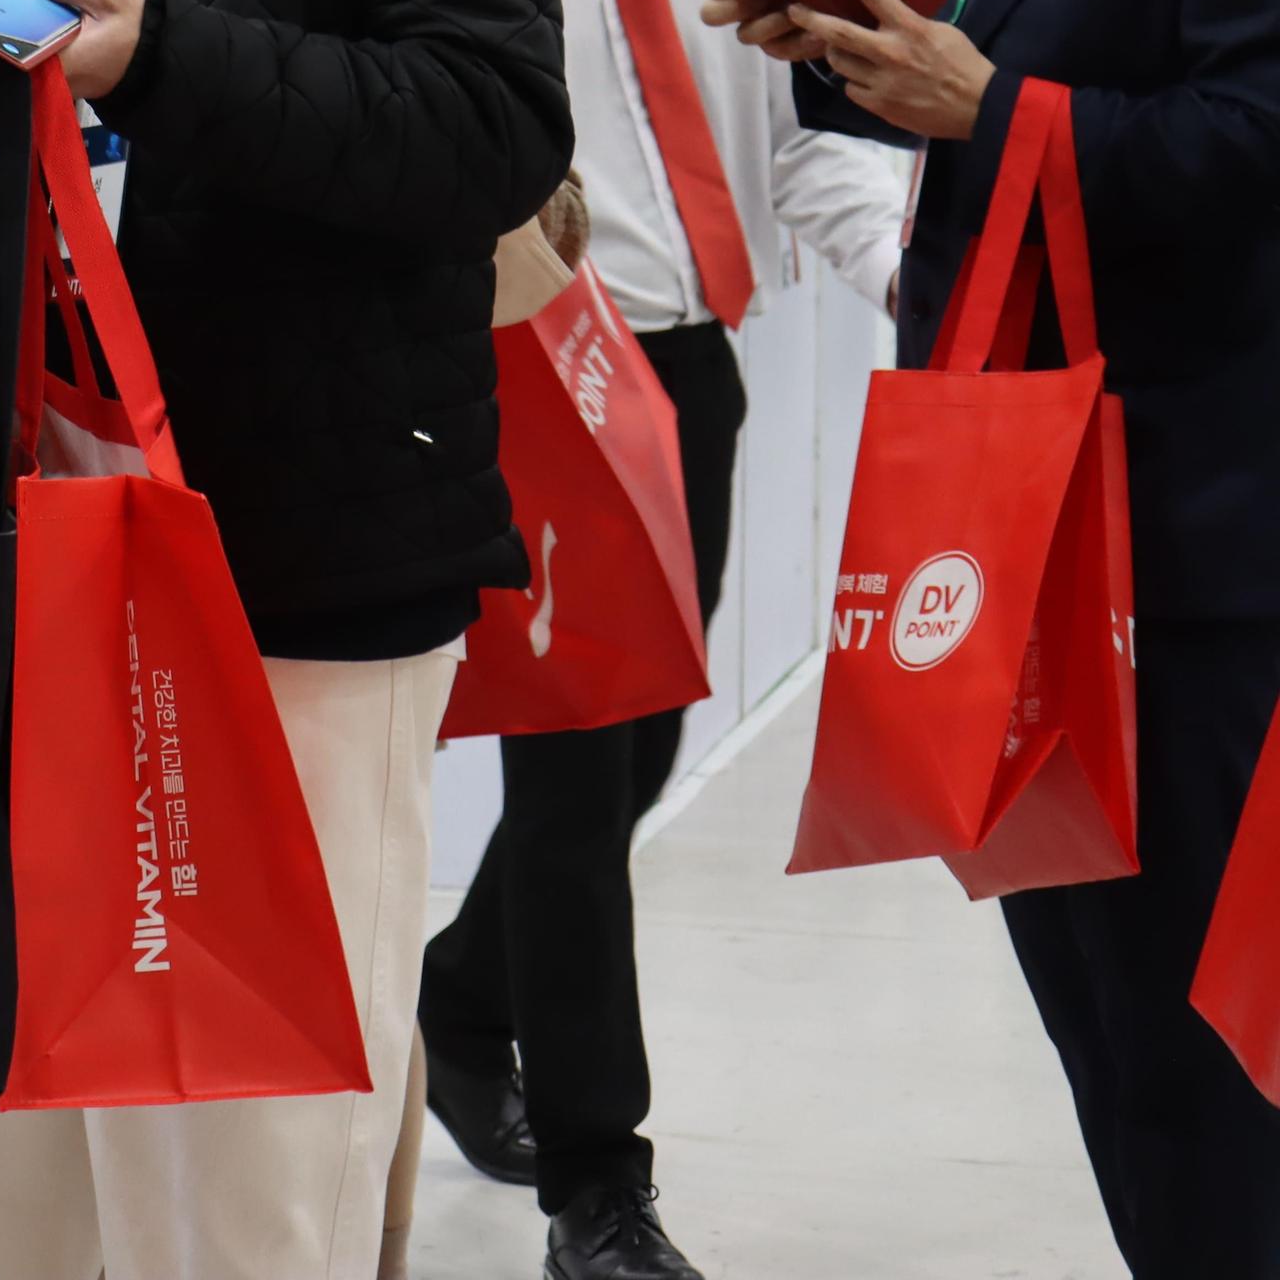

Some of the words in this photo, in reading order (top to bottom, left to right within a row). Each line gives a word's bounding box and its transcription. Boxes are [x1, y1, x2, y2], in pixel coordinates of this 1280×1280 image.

[856, 573, 888, 595] 체험
[919, 584, 966, 615] DV
[905, 620, 960, 639] POINT
[126, 600, 148, 782] DENTAL
[152, 669, 177, 729] 건강한
[160, 734, 185, 795] 치과를
[165, 799, 189, 860] 만드는
[132, 786, 171, 973] VITAMIN
[171, 863, 198, 897] 힘!
